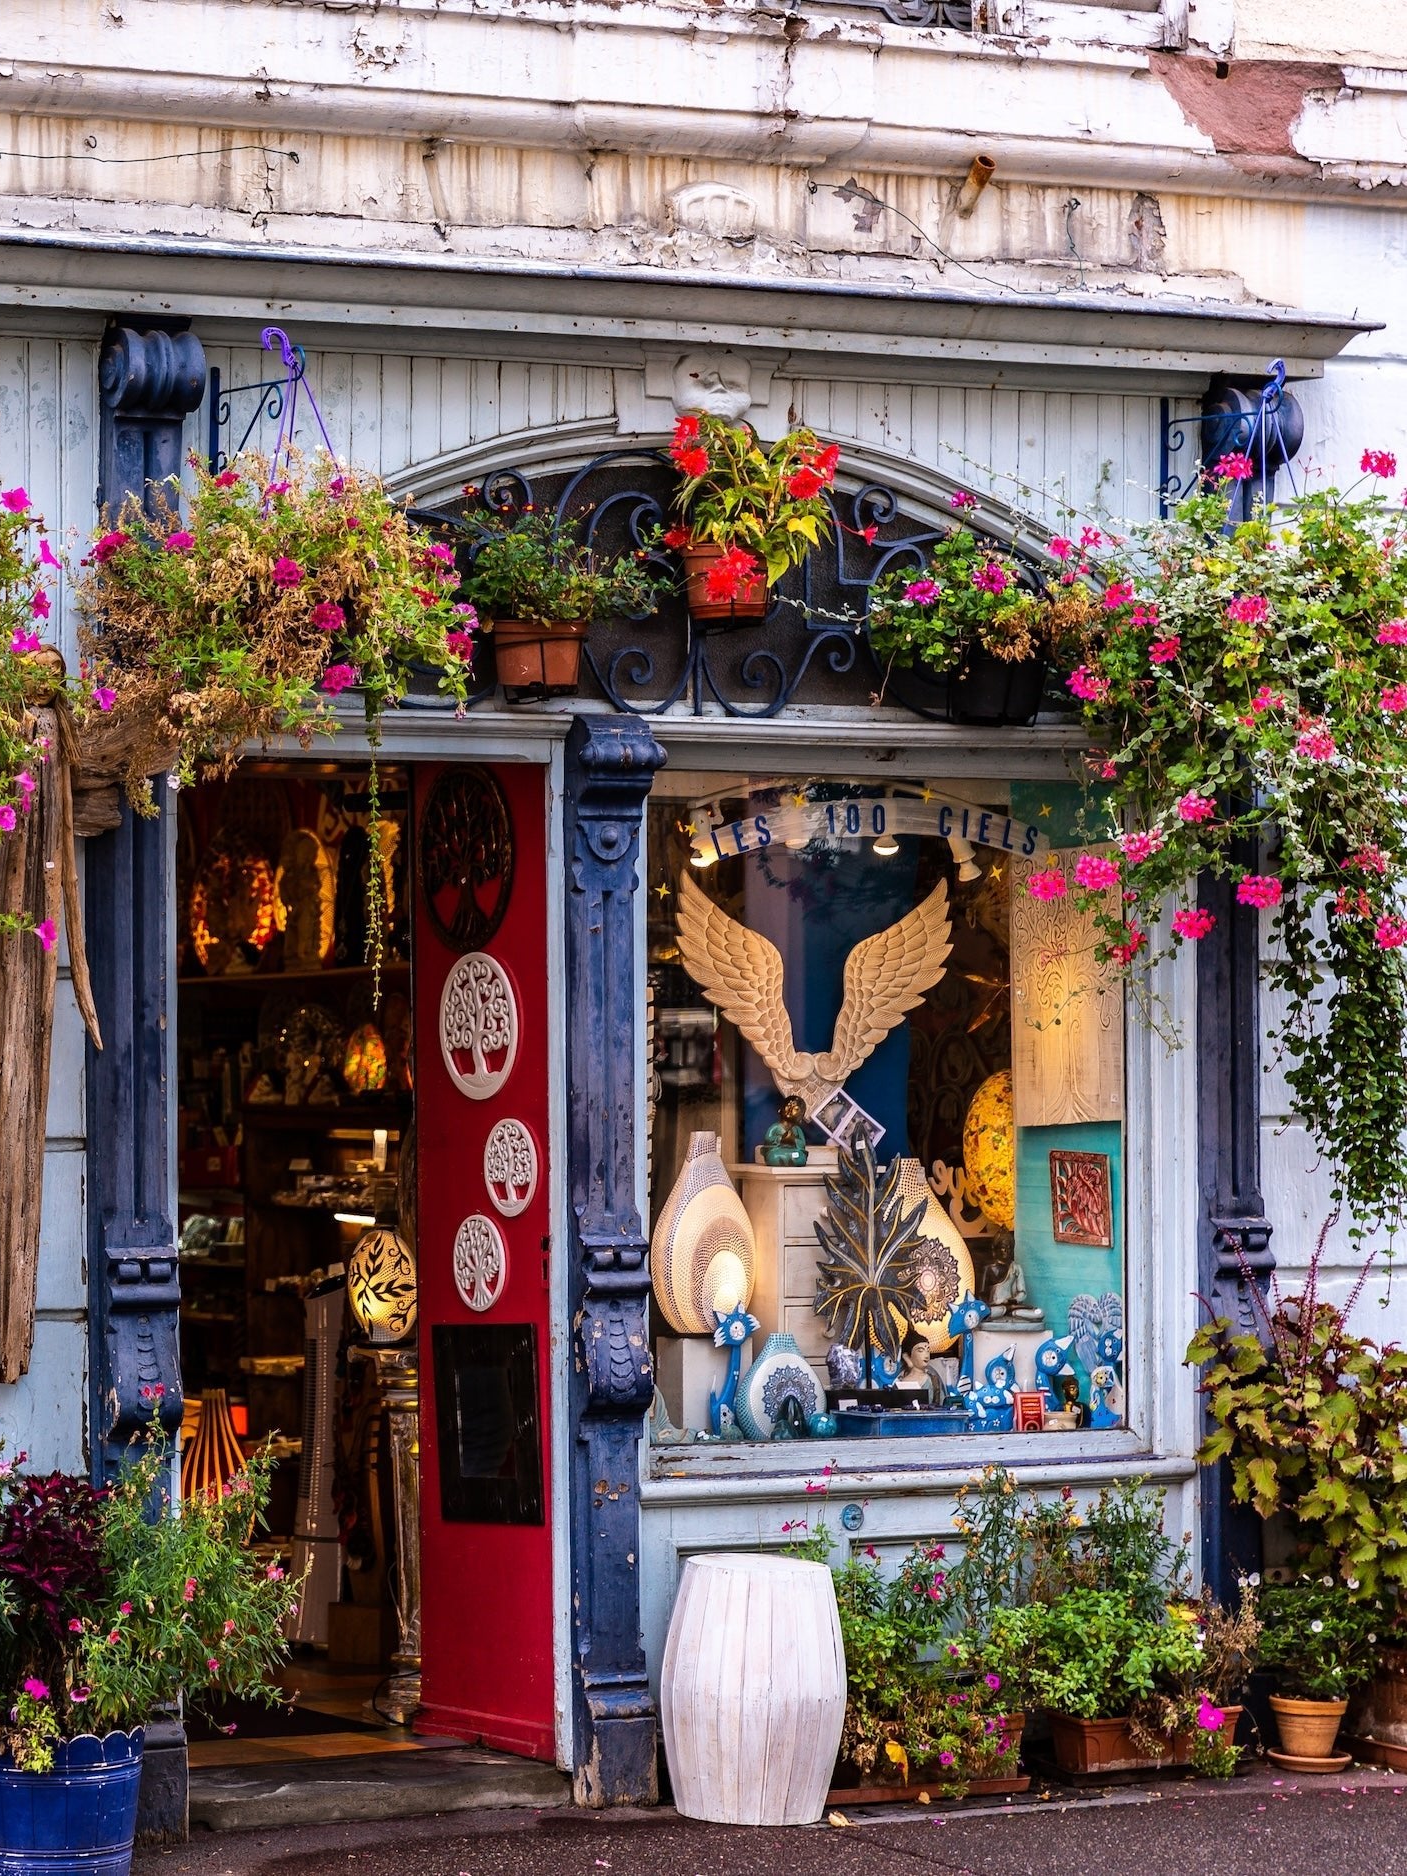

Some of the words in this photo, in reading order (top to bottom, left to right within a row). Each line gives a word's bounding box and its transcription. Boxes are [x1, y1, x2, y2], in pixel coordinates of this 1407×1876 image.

[710, 815, 772, 861] LES
[826, 803, 886, 835] 100
[939, 805, 1039, 856] CIELS
